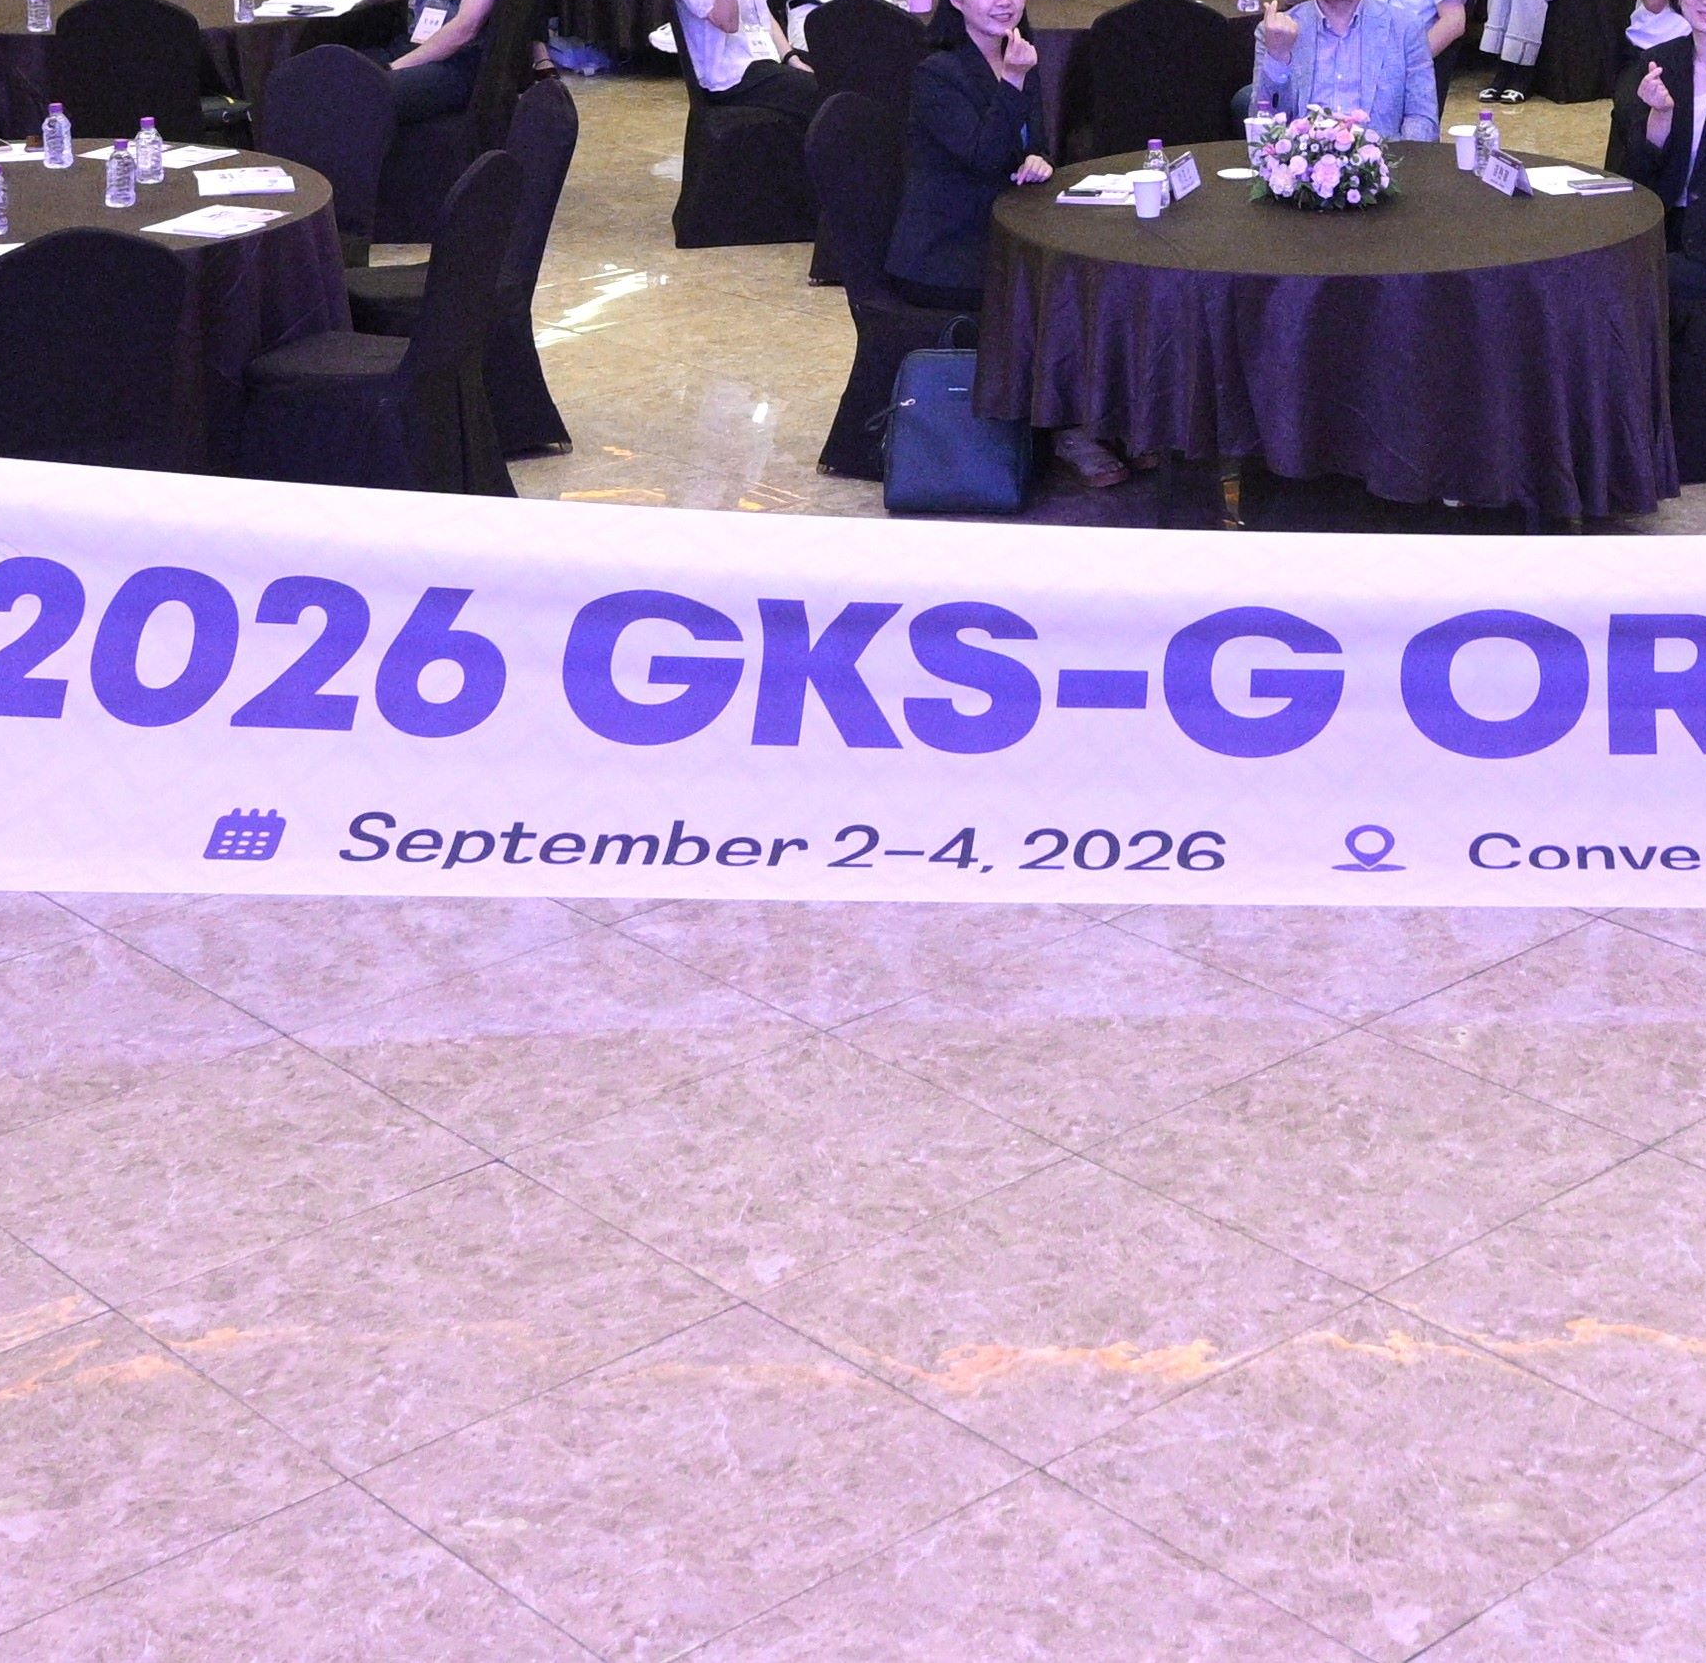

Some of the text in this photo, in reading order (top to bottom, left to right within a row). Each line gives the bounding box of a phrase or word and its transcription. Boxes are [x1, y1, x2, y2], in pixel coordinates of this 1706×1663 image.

[563, 590, 1344, 758] GKS-G
[340, 812, 808, 869] September
[1020, 829, 1225, 870] 2026
